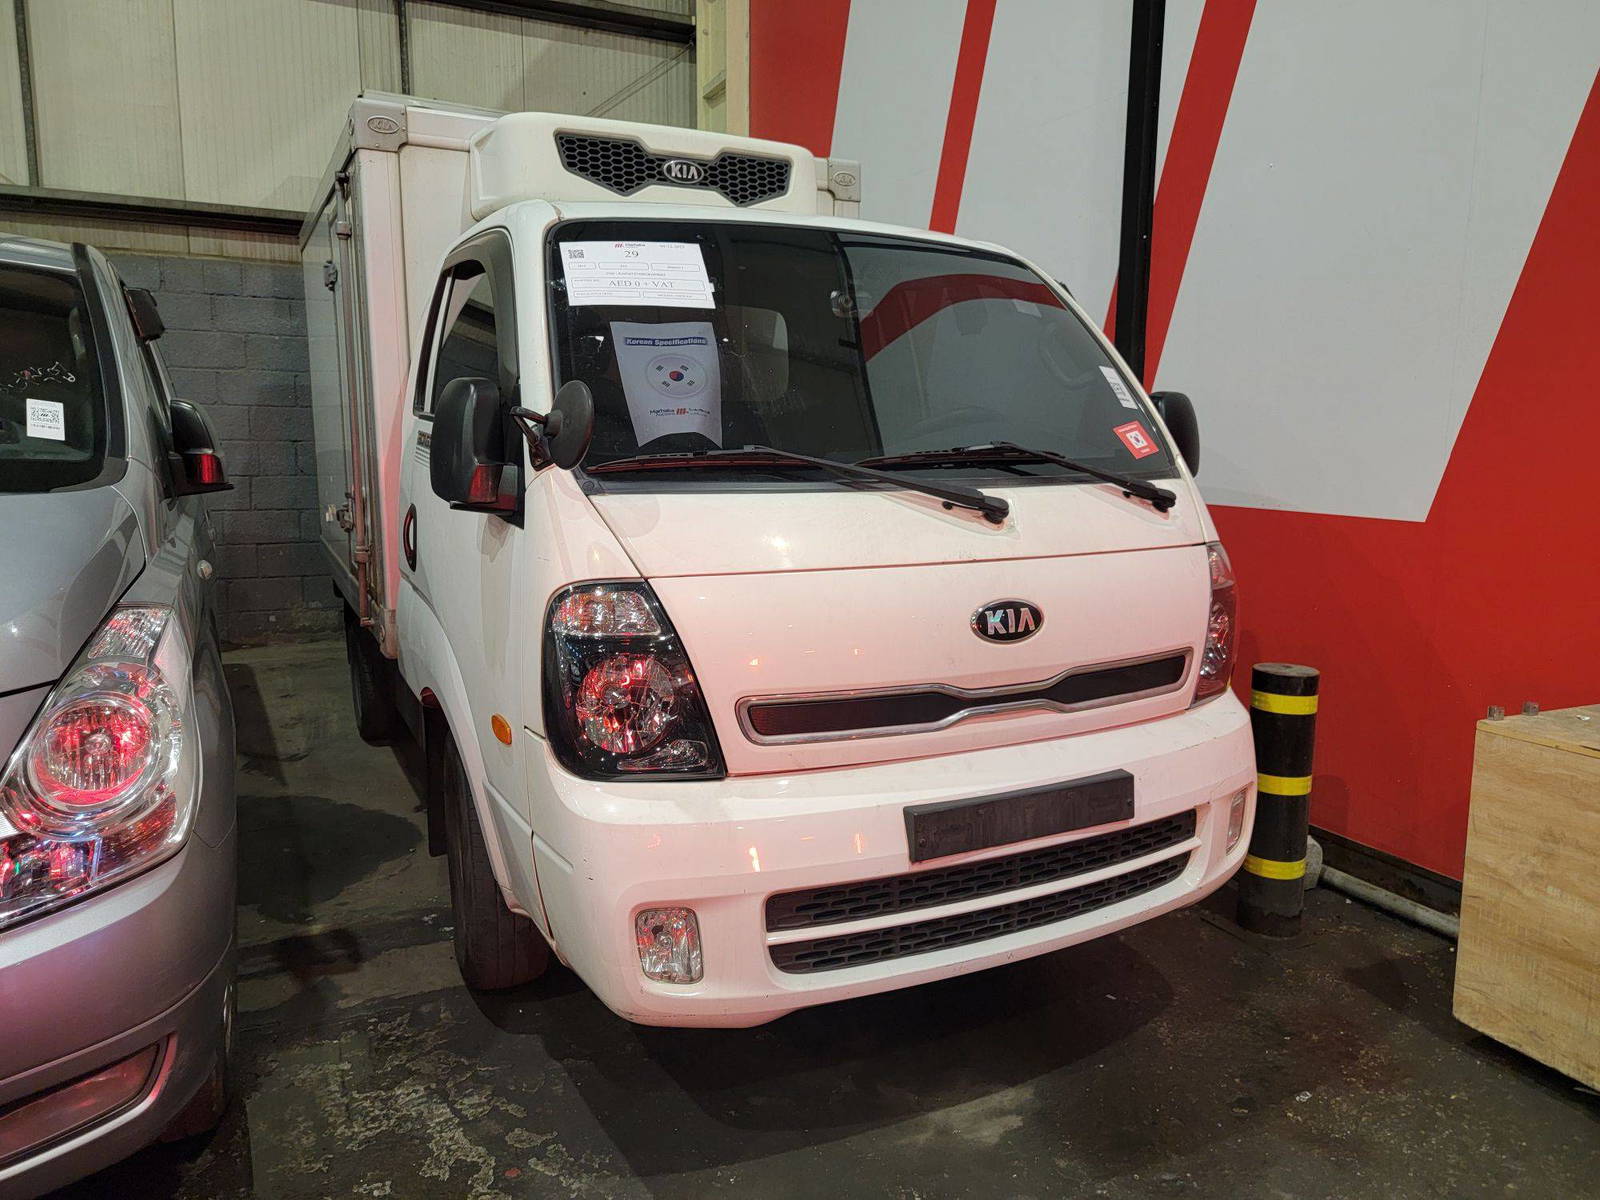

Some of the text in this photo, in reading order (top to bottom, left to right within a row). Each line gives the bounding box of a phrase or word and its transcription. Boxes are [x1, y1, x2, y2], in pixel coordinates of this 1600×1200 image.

[671, 162, 698, 179] KIA
[624, 250, 639, 258] 29
[608, 279, 632, 288] AED
[651, 280, 674, 289] VAT
[654, 337, 706, 346] Specifications
[984, 607, 1036, 635] KIA
